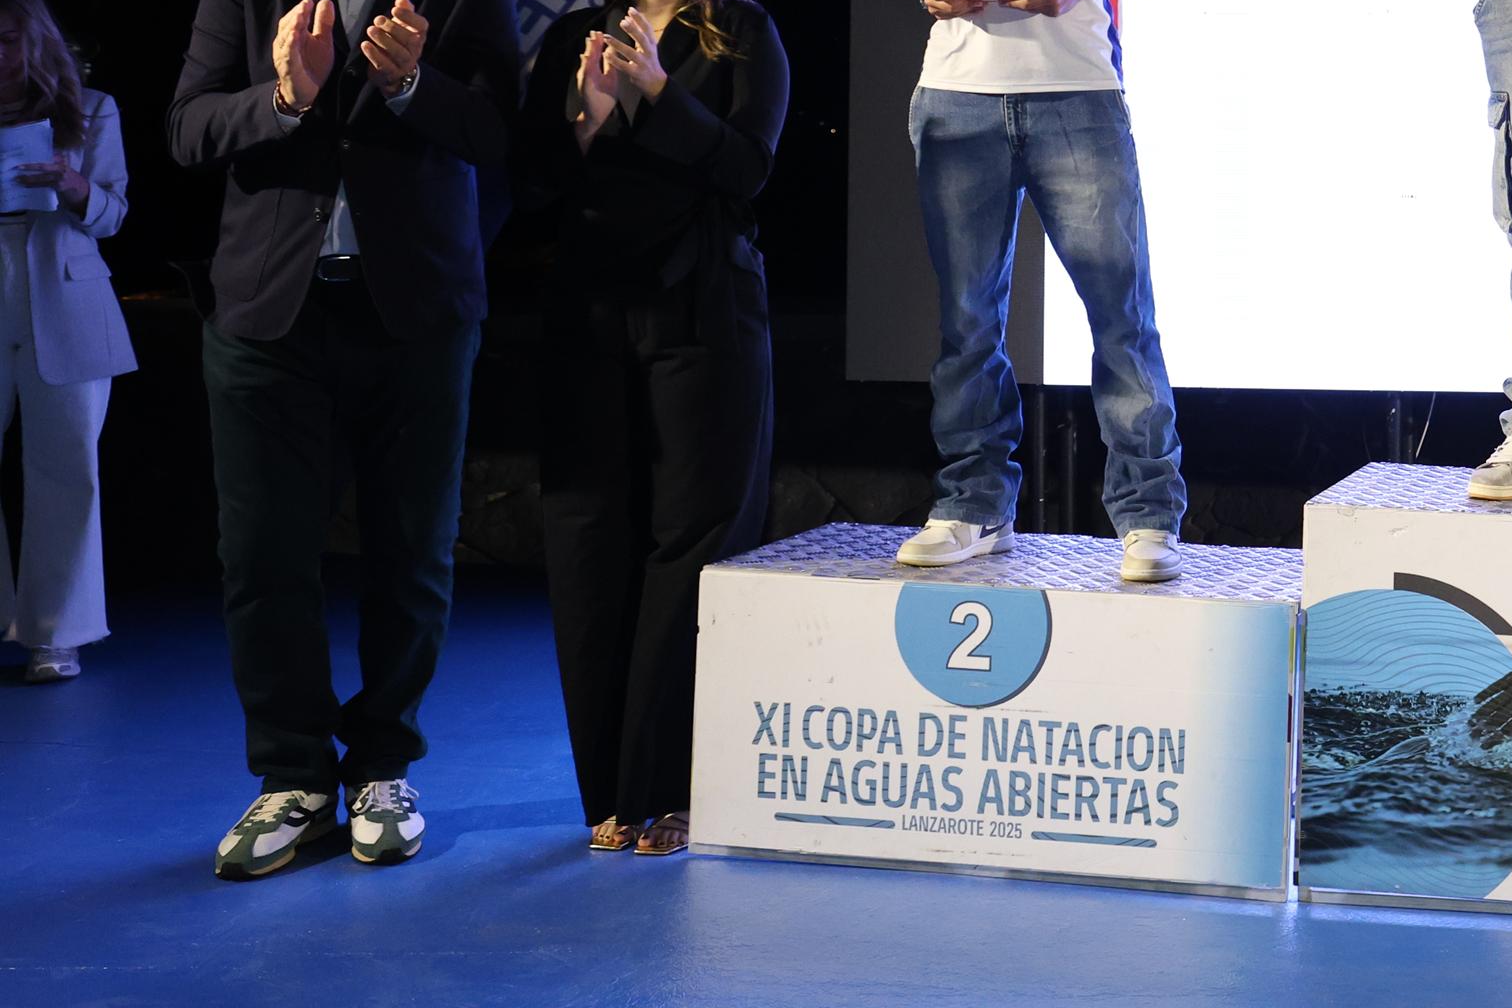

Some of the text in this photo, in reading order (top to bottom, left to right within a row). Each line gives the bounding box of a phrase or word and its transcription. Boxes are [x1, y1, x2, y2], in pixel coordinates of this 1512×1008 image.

[946, 600, 993, 672] 2
[752, 700, 1186, 775] XI COPA DE NATACION
[757, 752, 1180, 828] EN AGUAS ABIERTAS
[901, 814, 1023, 840] LANZAROTE 2025
